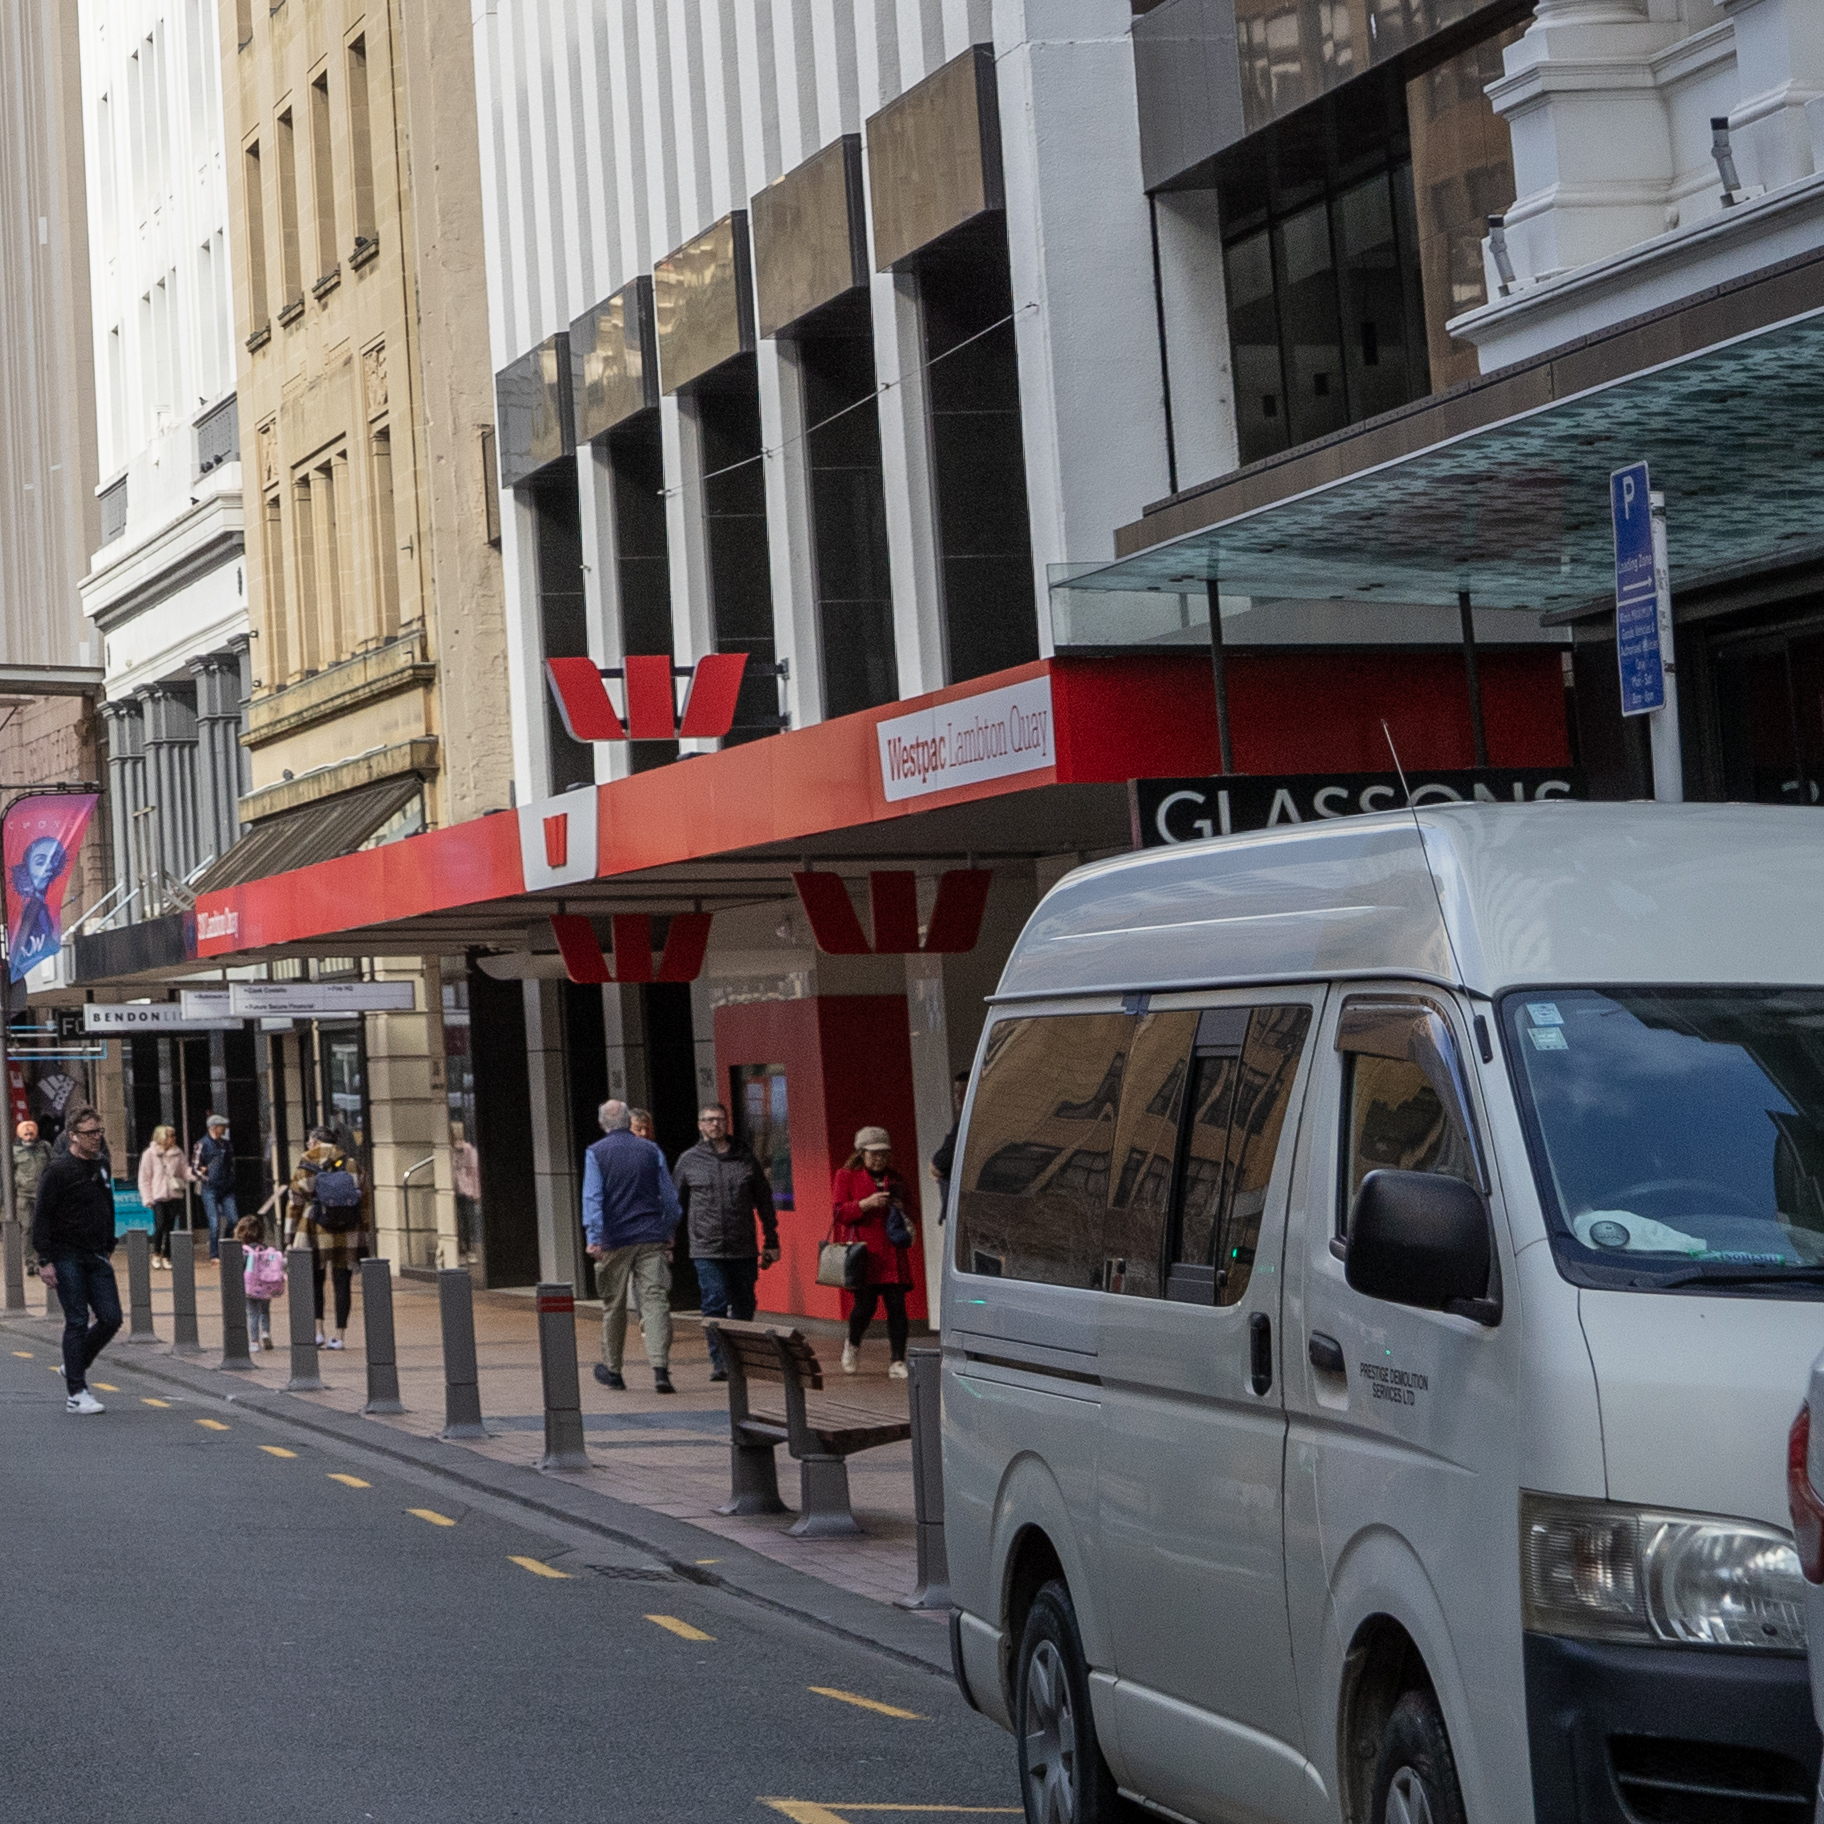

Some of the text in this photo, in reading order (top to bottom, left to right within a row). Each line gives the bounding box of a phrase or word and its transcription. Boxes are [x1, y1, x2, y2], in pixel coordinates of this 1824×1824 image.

[1622, 475, 1635, 520] P
[887, 704, 1047, 784] Westpac Lambton Quay
[92, 1009, 161, 1022] BENDON
[1359, 1361, 1429, 1391] PRESTIGE DEMOLITION
[1372, 1382, 1402, 1404] SERVICES
